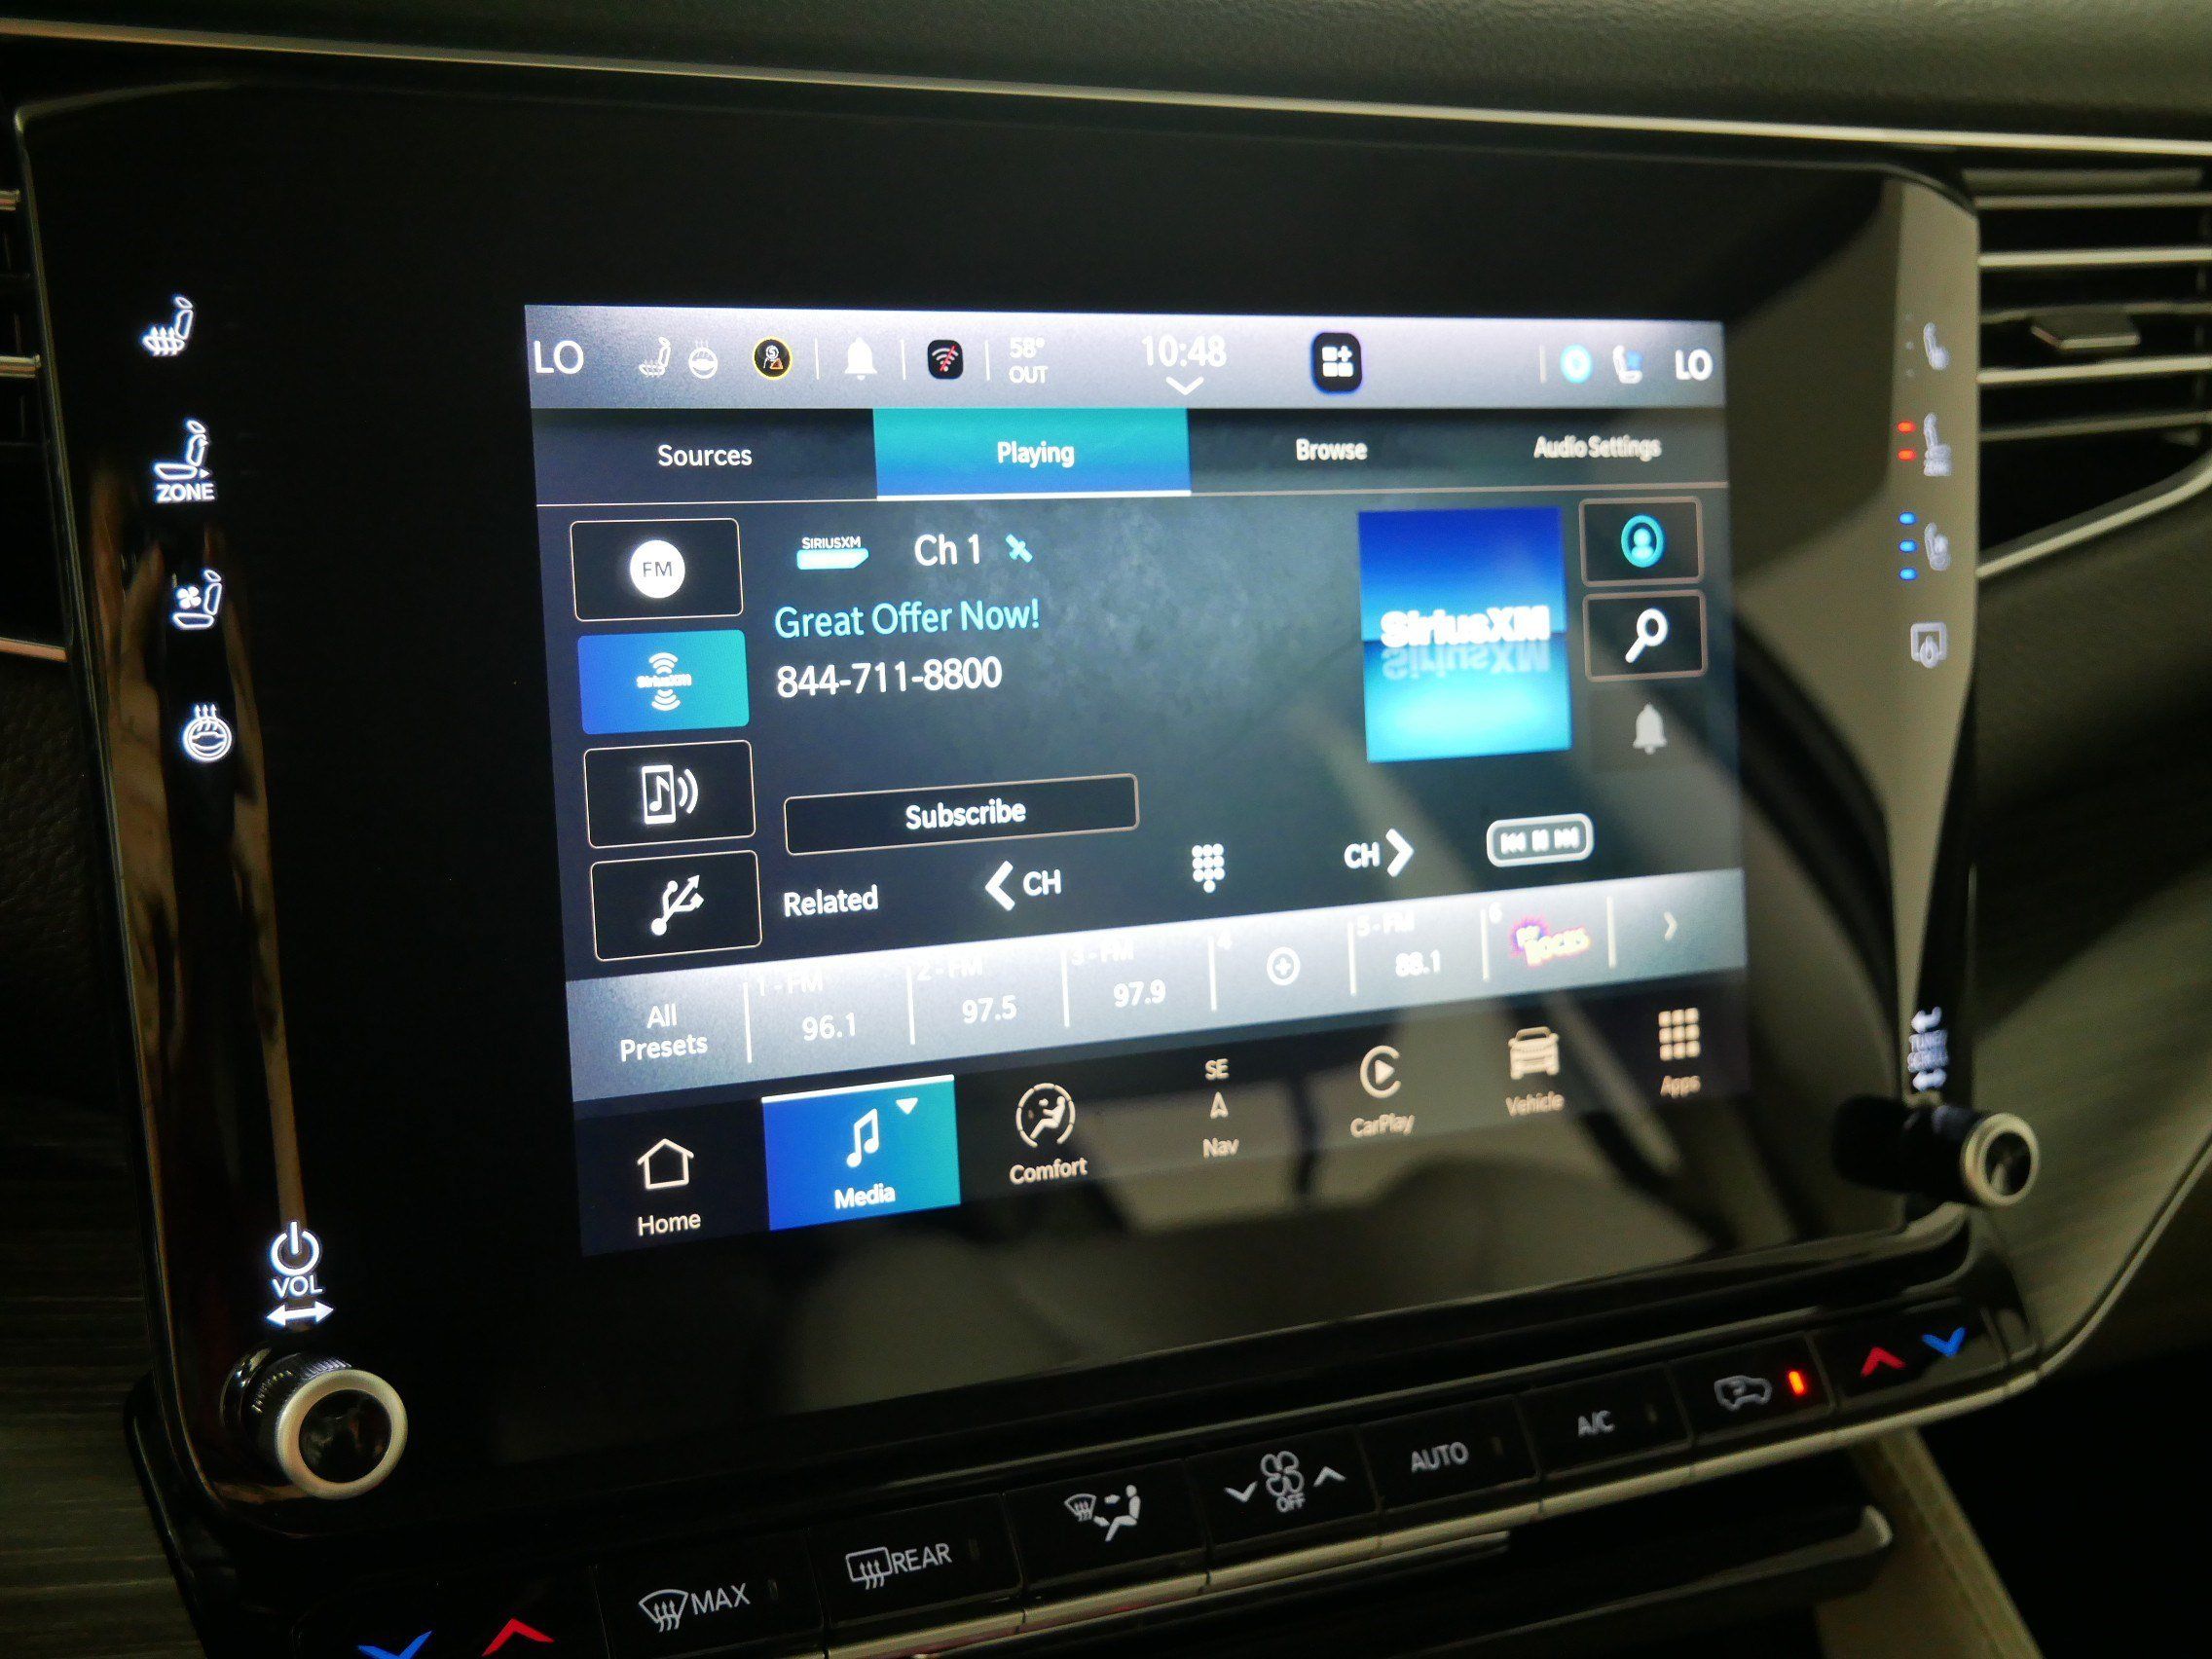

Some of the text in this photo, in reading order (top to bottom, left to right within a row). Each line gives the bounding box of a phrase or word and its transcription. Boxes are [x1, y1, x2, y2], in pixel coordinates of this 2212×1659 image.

[534, 340, 584, 374] LO
[1141, 334, 1228, 369] 10:48
[1675, 348, 1714, 381] LO
[1009, 365, 1049, 385] OUT
[657, 443, 753, 467] Sources
[997, 441, 1076, 468] Playing
[1296, 438, 1369, 461] Browse
[1533, 434, 1663, 462] Audio Settings
[155, 482, 216, 504] ZONE
[801, 535, 862, 550] SIRIUSXM
[913, 534, 980, 567] Ch 1
[642, 560, 674, 578] FM
[775, 598, 1041, 640] Great Offer Now!
[1381, 605, 1551, 647] SiriusXM
[776, 655, 1003, 698] 844-711-8800
[904, 799, 1027, 830] Subscribe
[1344, 841, 1381, 868] CH
[1022, 869, 1062, 897] CH
[783, 884, 879, 917] Related
[1113, 979, 1166, 1009] 97.9
[646, 1004, 678, 1028] All
[962, 996, 1017, 1024] 97.5
[801, 1013, 857, 1041] 96.1
[620, 1034, 708, 1062] Presets
[1204, 1058, 1230, 1080] SE
[1659, 1075, 1702, 1097] Apps
[1504, 1091, 1566, 1117] Vehicle
[1349, 1111, 1416, 1139] CarPlay
[1201, 1135, 1240, 1159] Nav
[1009, 1157, 1088, 1186] Comfort
[834, 1184, 897, 1210] Media
[637, 1210, 702, 1237] Home
[271, 1274, 324, 1299] VOL
[1576, 1409, 1616, 1439] A/C
[1410, 1441, 1470, 1474] AUTO
[1274, 1492, 1307, 1514] OFF
[891, 1541, 953, 1574] REAR
[689, 1581, 752, 1617] MAX
